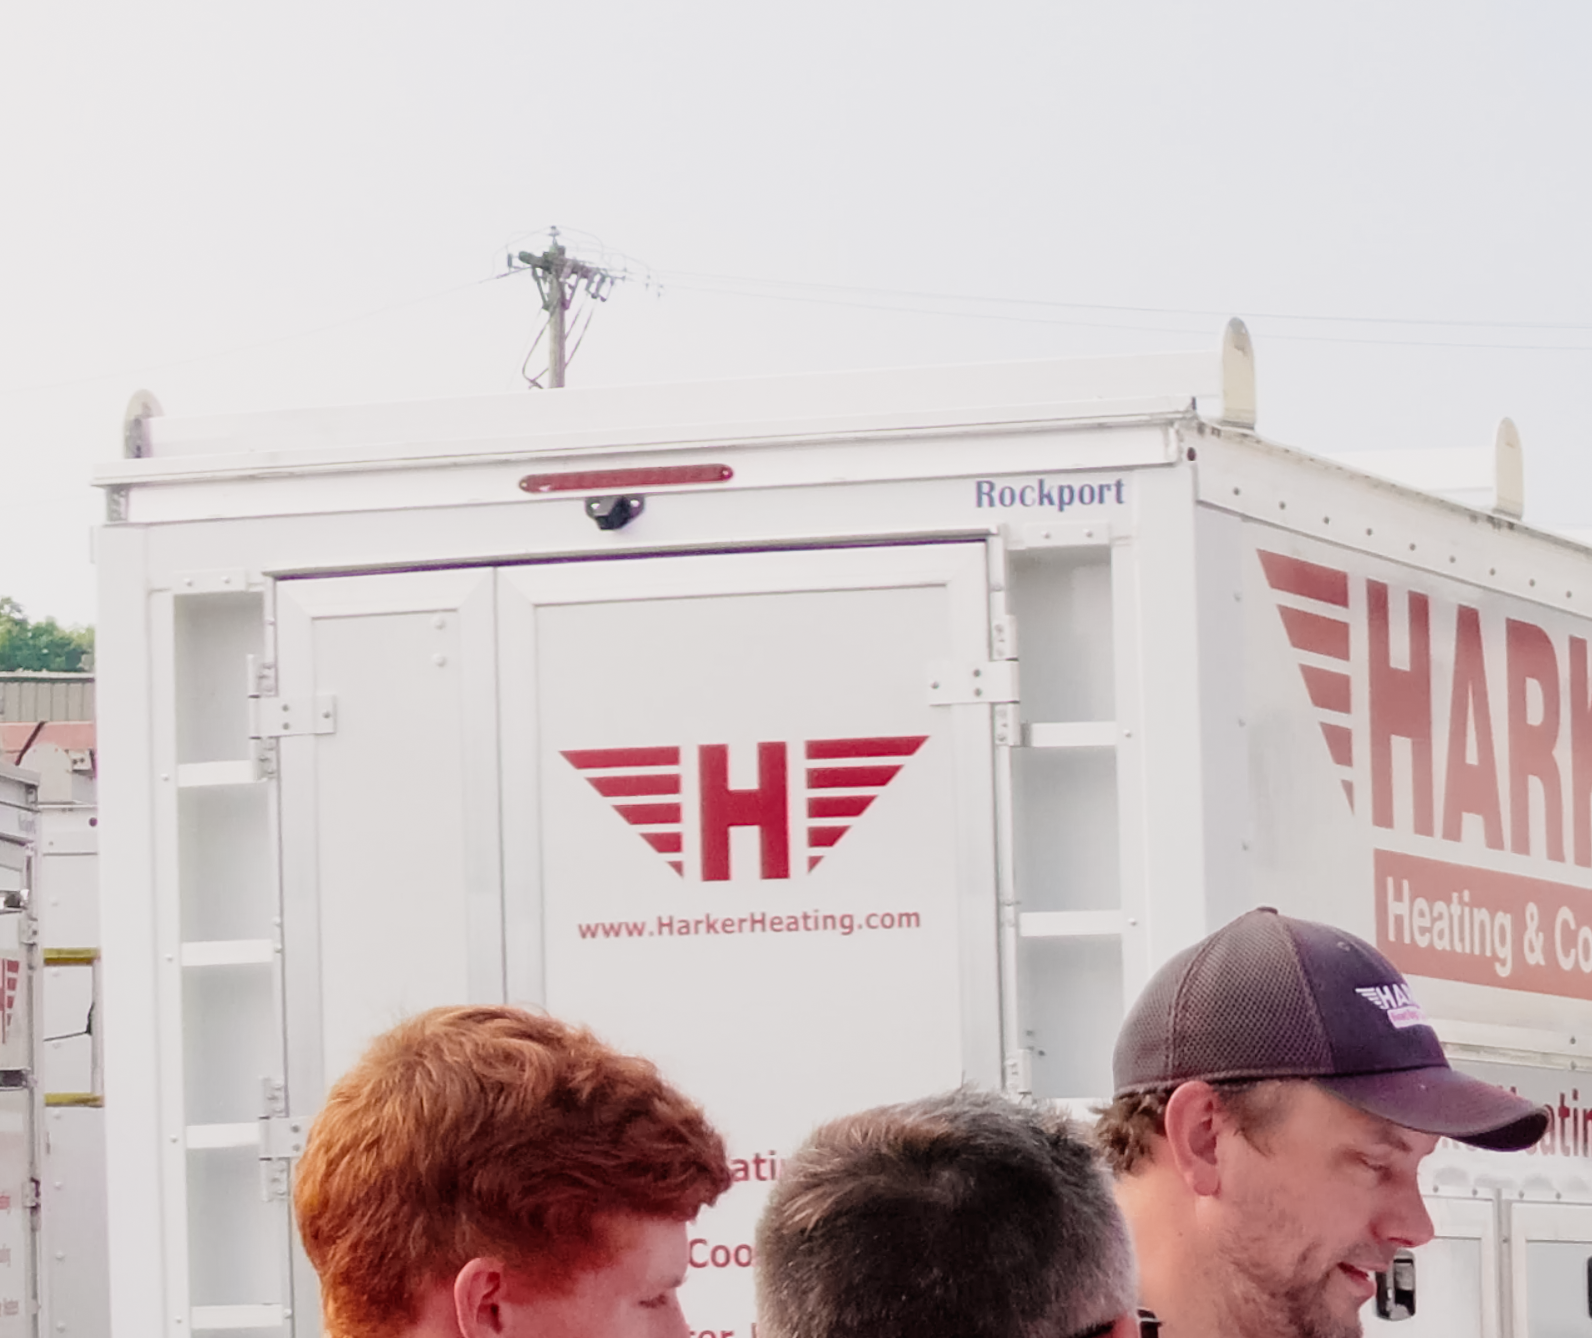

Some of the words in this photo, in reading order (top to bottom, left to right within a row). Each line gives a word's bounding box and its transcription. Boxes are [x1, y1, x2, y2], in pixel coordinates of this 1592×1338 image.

[975, 477, 1126, 513] Rockport
[698, 741, 790, 882] H
[578, 907, 922, 940] www.HarkerHeating.com
[1387, 876, 1514, 977] Heating
[1523, 902, 1545, 967] &
